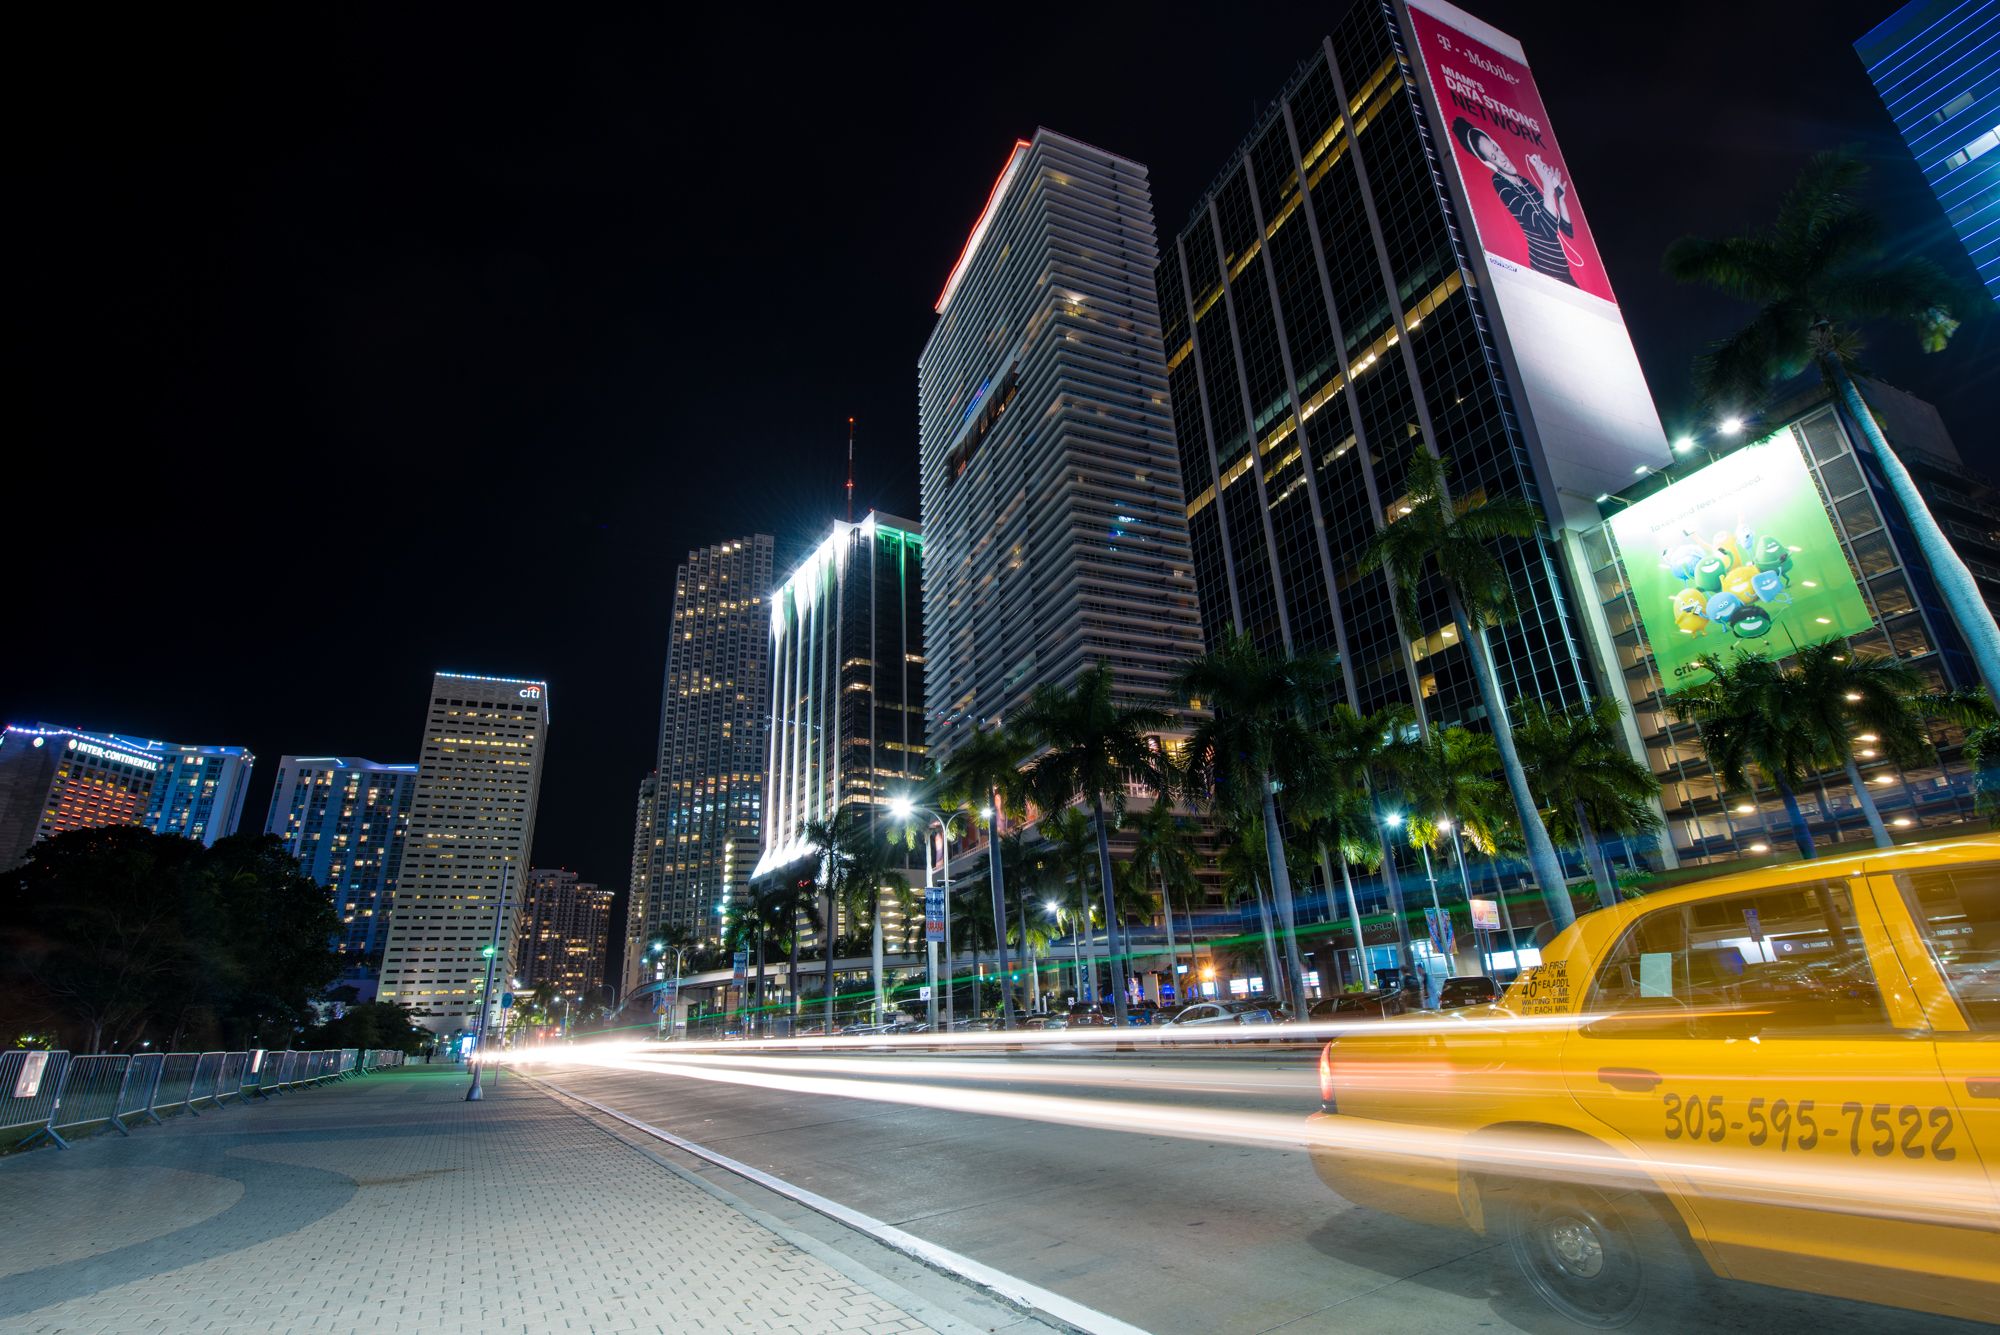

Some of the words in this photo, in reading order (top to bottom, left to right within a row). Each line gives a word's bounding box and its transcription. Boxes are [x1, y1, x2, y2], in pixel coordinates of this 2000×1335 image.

[1441, 64, 1485, 94] MIAMI'S
[1445, 75, 1483, 105] DATA
[1483, 94, 1540, 133] STRONG
[1450, 90, 1548, 150] NETWORK
[519, 687, 540, 699] citi
[1550, 960, 1568, 969] FIRST
[1521, 998, 1551, 1006] WAITING
[1534, 1005, 1553, 1015] EACH
[1663, 1092, 1957, 1161] 305-595-7522
